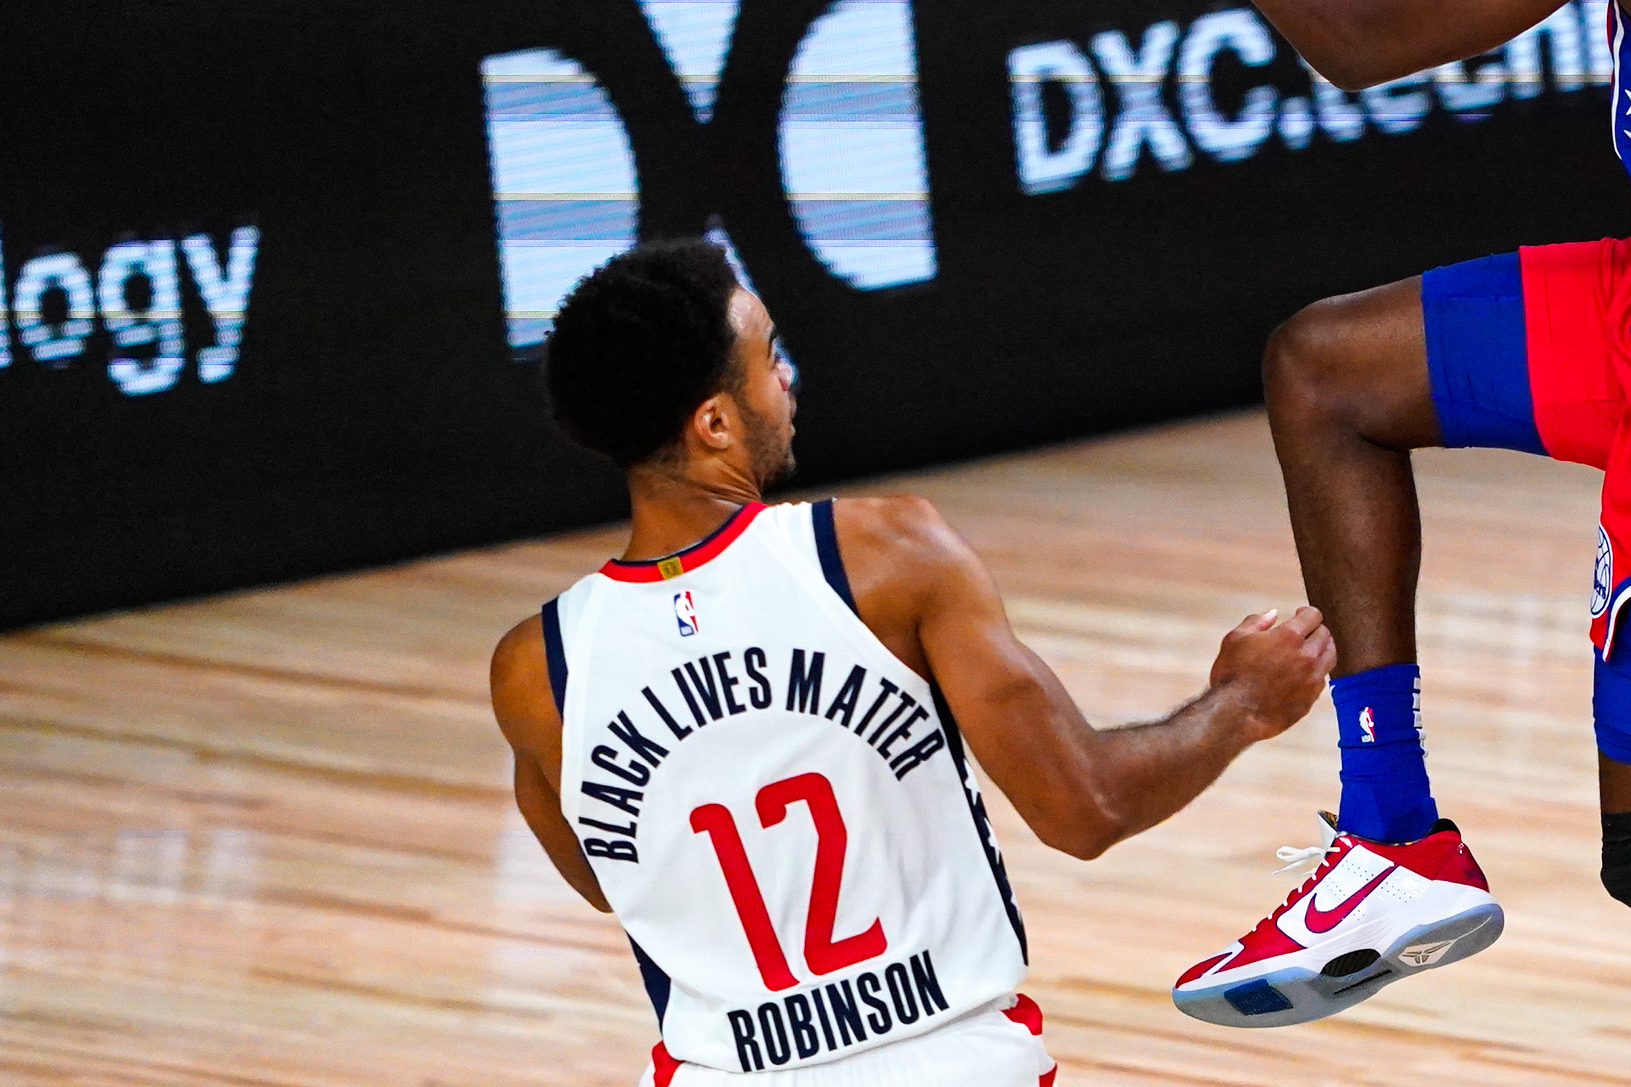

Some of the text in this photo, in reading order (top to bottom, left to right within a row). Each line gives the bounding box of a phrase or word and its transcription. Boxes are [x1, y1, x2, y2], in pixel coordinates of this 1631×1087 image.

[577, 646, 947, 864] BLACK LIVES MATTER
[688, 771, 888, 992] 12
[727, 948, 951, 1074] ROBINSON
